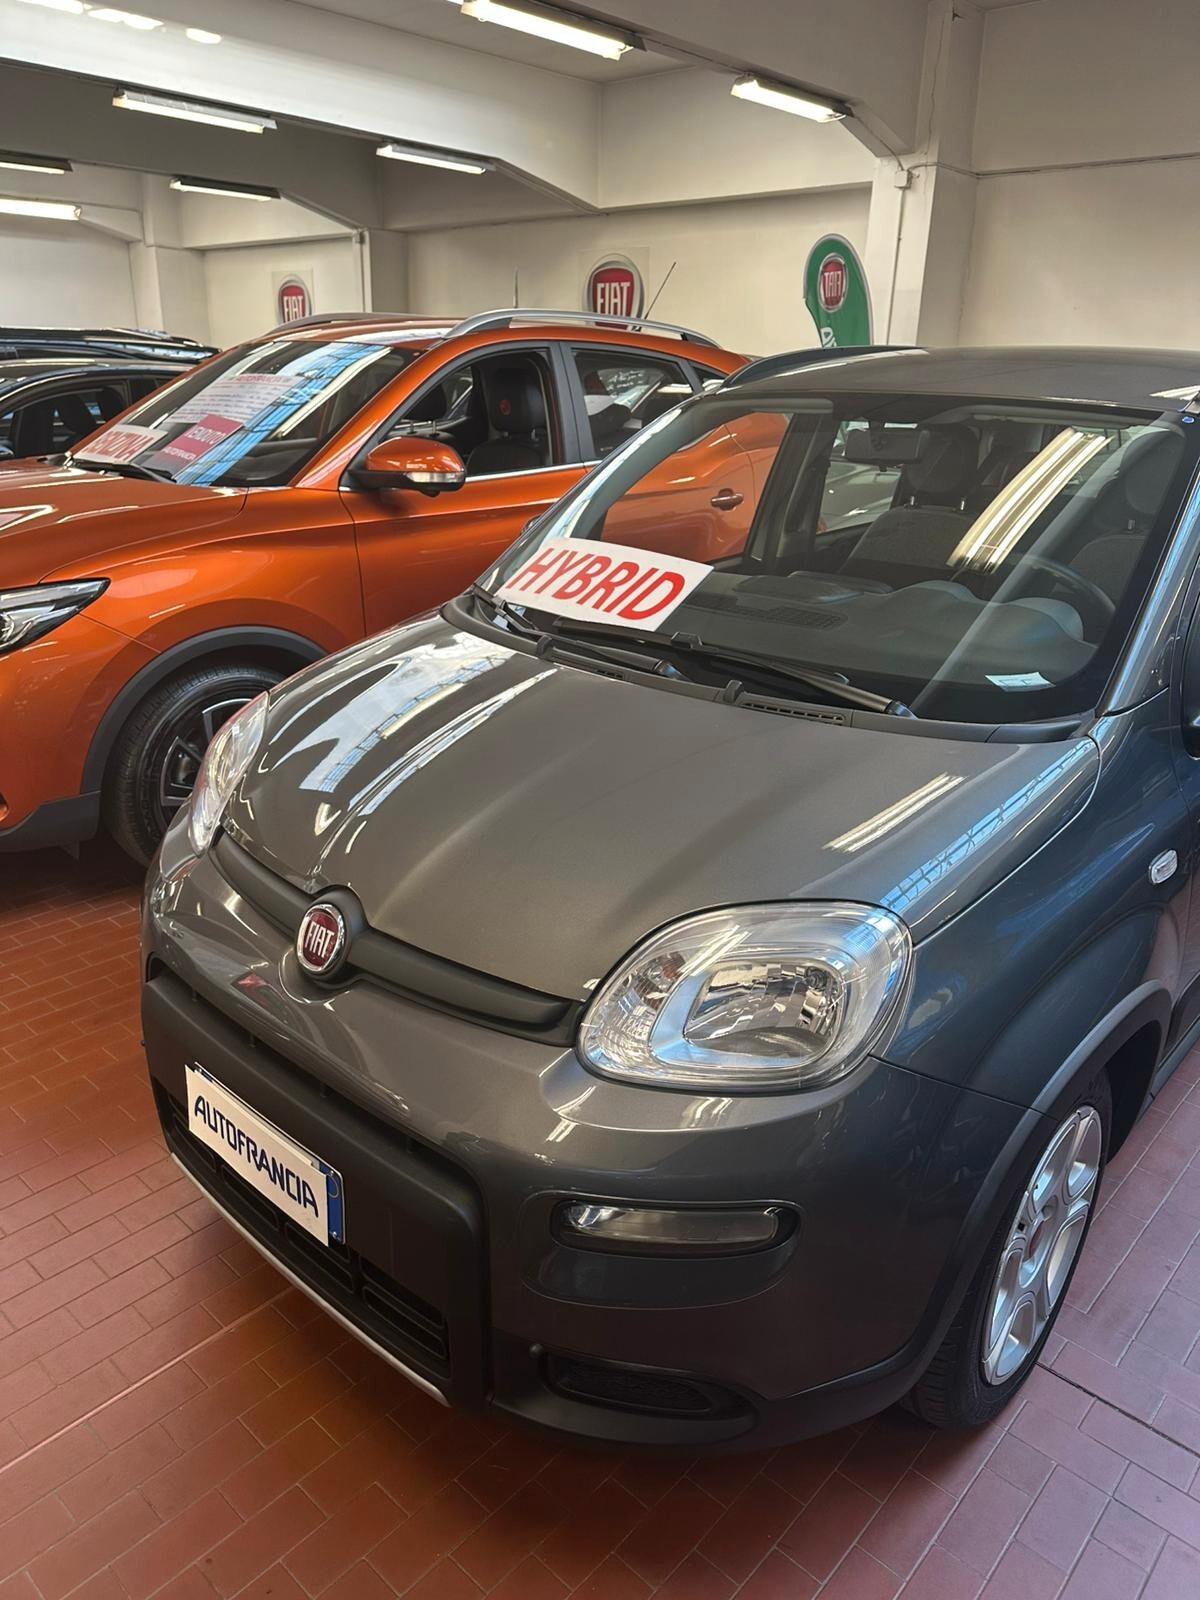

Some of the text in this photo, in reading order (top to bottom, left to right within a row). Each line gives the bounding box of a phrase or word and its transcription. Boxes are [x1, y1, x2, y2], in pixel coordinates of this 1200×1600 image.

[283, 295, 304, 323] FIAT
[596, 282, 631, 317] FIAT
[505, 547, 686, 620] HYBRID
[305, 920, 335, 958] FIAT
[194, 1095, 319, 1218] AUTOFRANCIA
